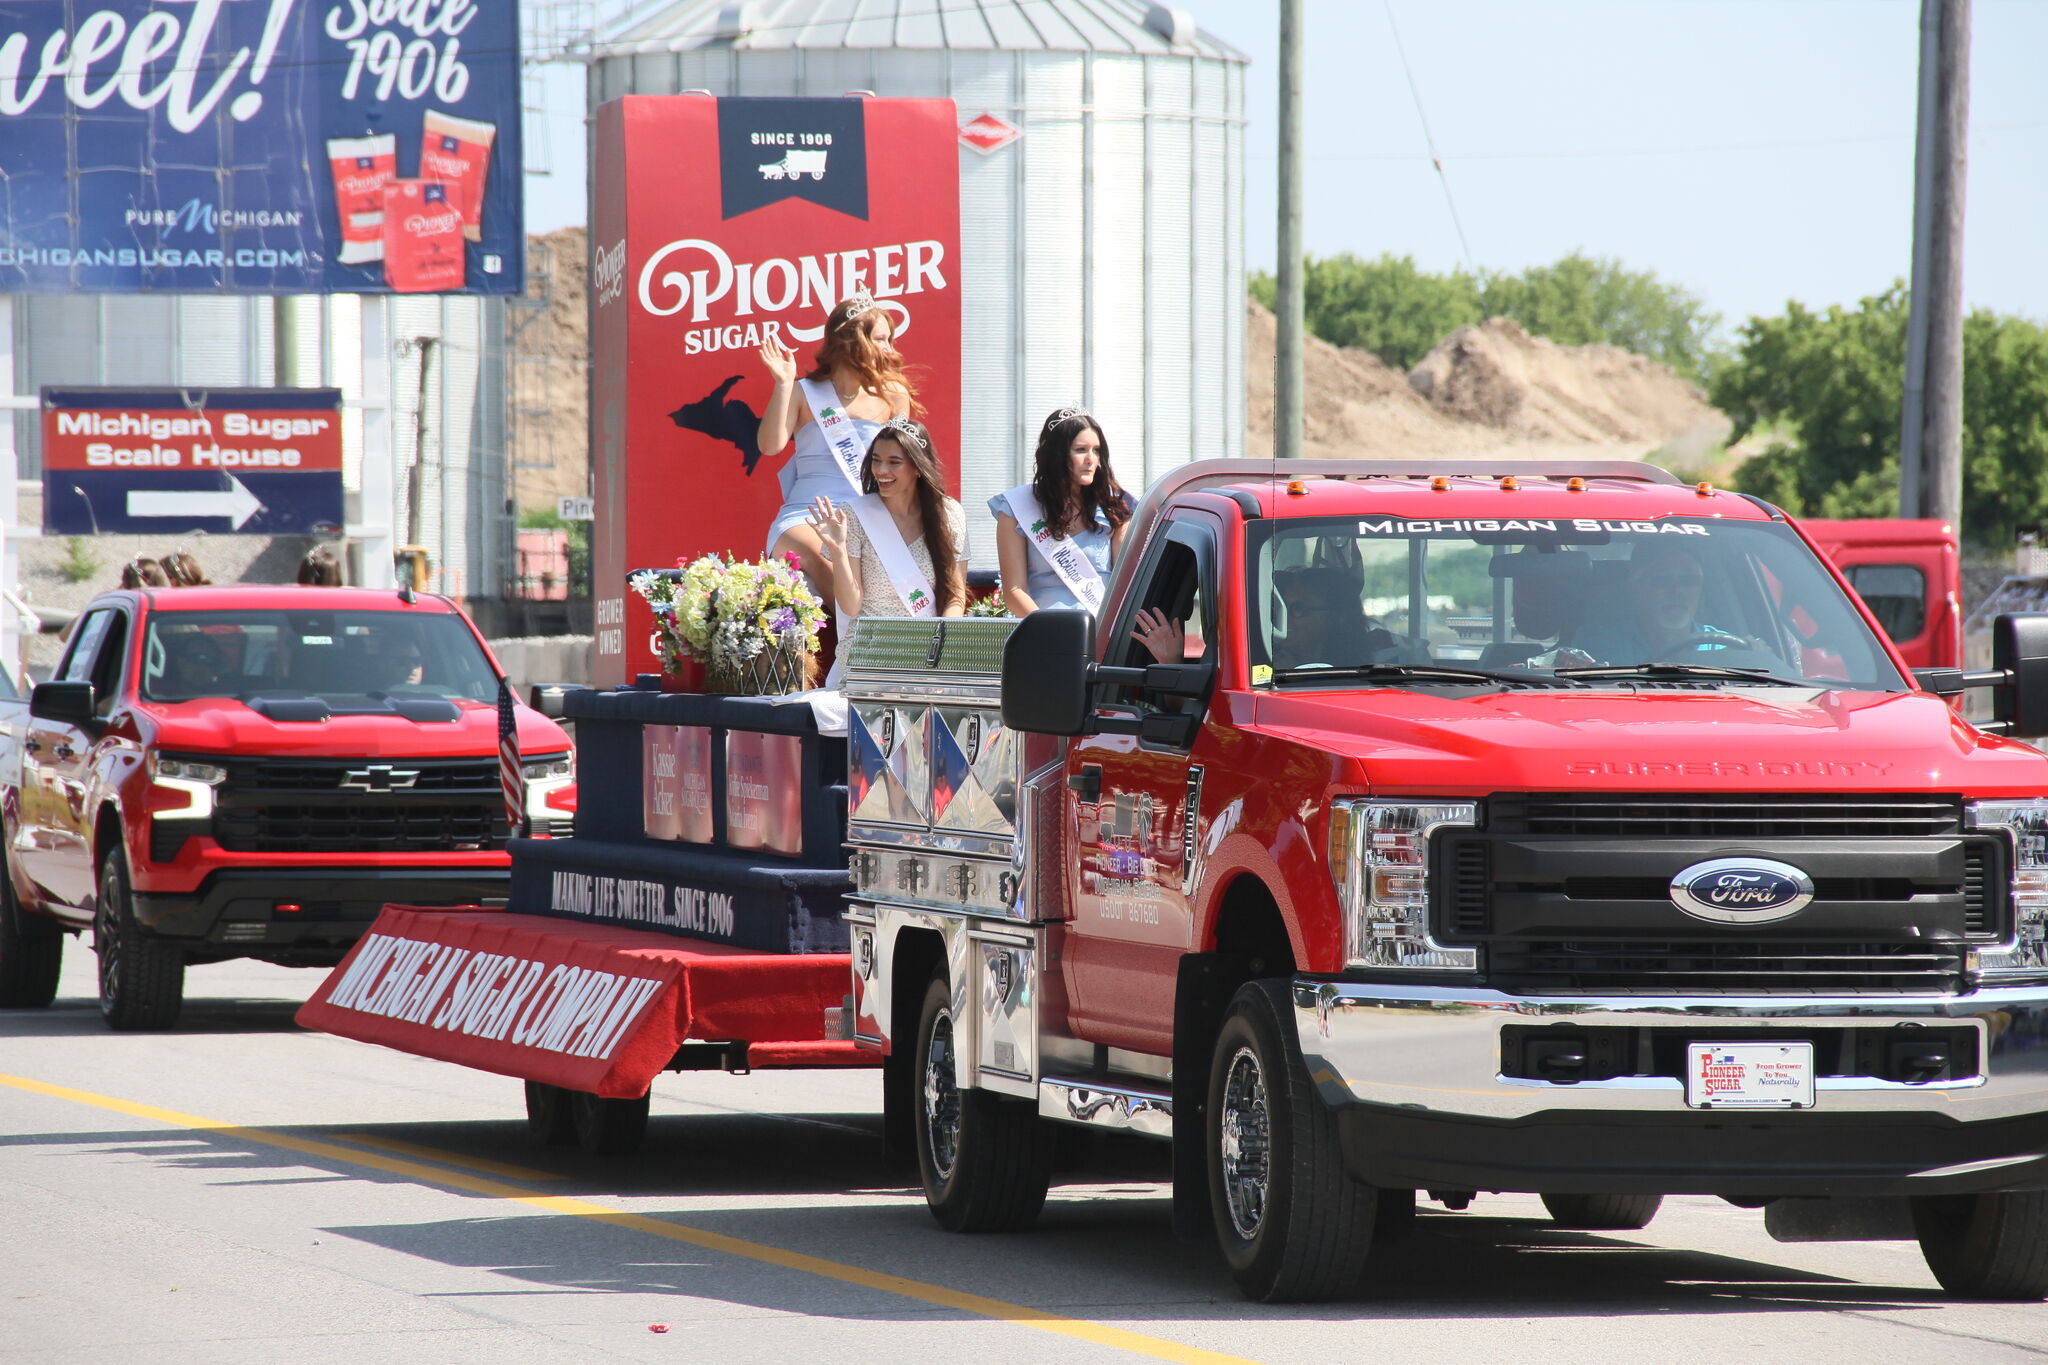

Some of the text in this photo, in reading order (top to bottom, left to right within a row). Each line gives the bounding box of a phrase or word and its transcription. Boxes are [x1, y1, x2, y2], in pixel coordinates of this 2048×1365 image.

[340, 30, 470, 104] 1906
[751, 132, 833, 145] SINCE 1906
[124, 197, 302, 239] PURE MICHIGAN
[637, 238, 947, 323] PIONEER
[684, 320, 799, 356] SUGAR
[56, 412, 329, 440] Michigan Sugar
[85, 443, 301, 467] Scale House
[563, 499, 595, 516] Pin
[1358, 518, 1711, 536] MICHIGAN SUGAR
[1566, 761, 1895, 777] SUPER DUTY
[1711, 874, 1779, 904] Ford
[551, 871, 593, 916] MAKING
[594, 876, 616, 918] LIFE
[708, 892, 735, 937] 1906
[326, 933, 663, 1060] MICHIGAN SUGAR COMPANY
[1701, 1053, 1746, 1078] PIONEER
[1705, 1078, 1742, 1096] SUGAR
[1759, 1077, 1801, 1088] Naturally
